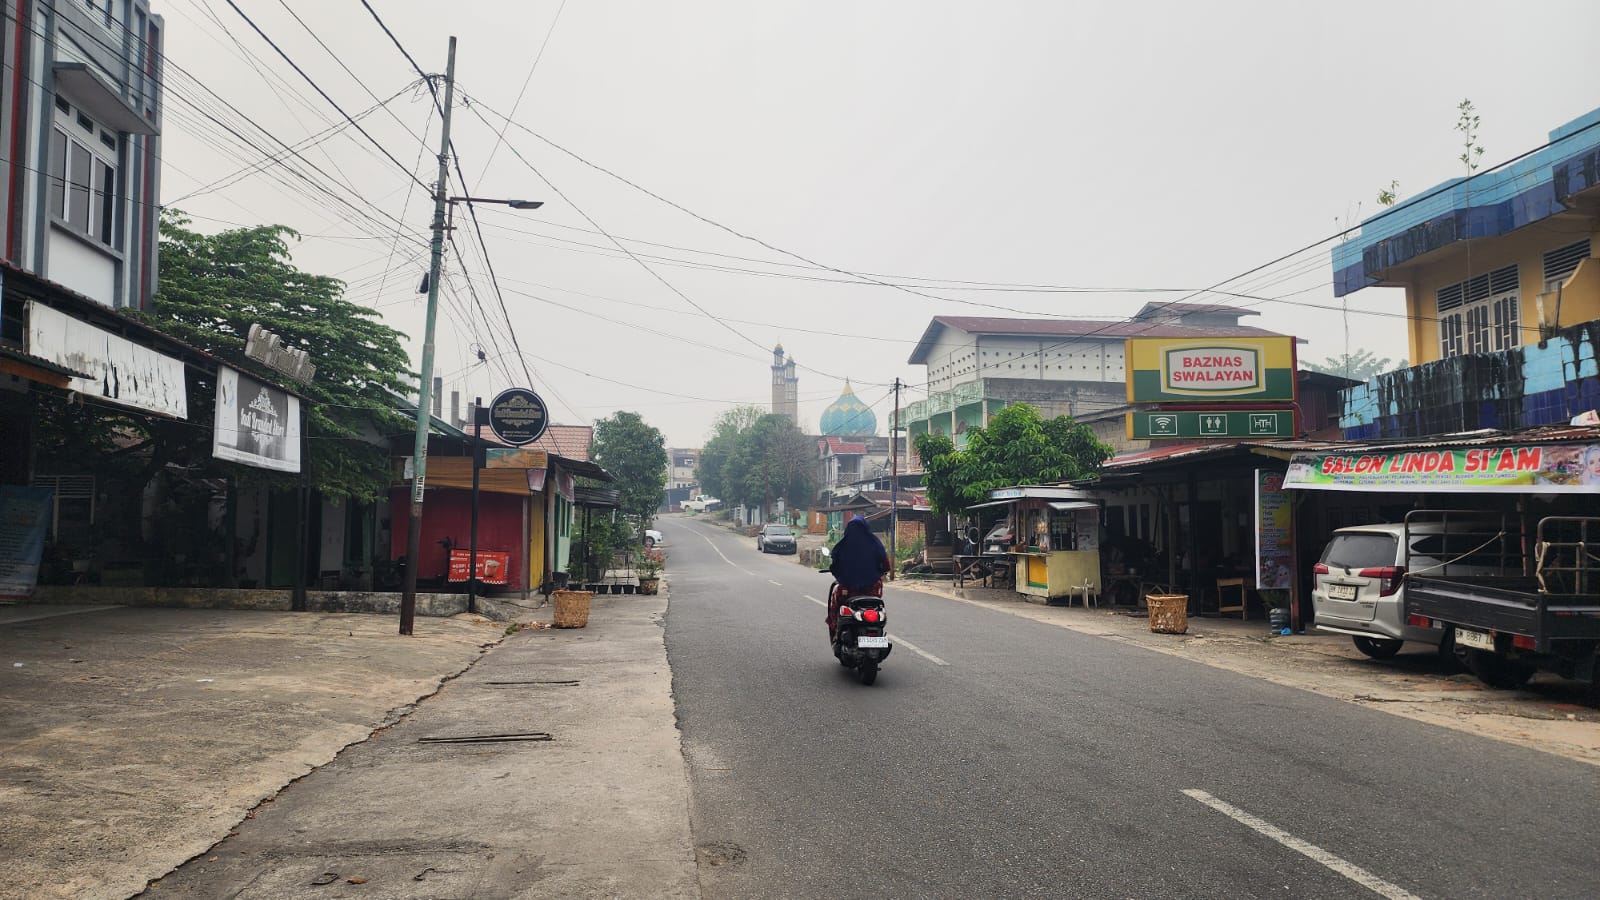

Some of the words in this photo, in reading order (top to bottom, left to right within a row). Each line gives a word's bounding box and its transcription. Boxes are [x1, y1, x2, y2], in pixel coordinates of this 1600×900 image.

[1182, 356, 1242, 368] BAZNAS
[1173, 370, 1253, 382] SWALAYAN
[1322, 455, 1387, 475] SALON
[1389, 451, 1455, 473] LINDA
[1464, 447, 1543, 473] SI'AM
